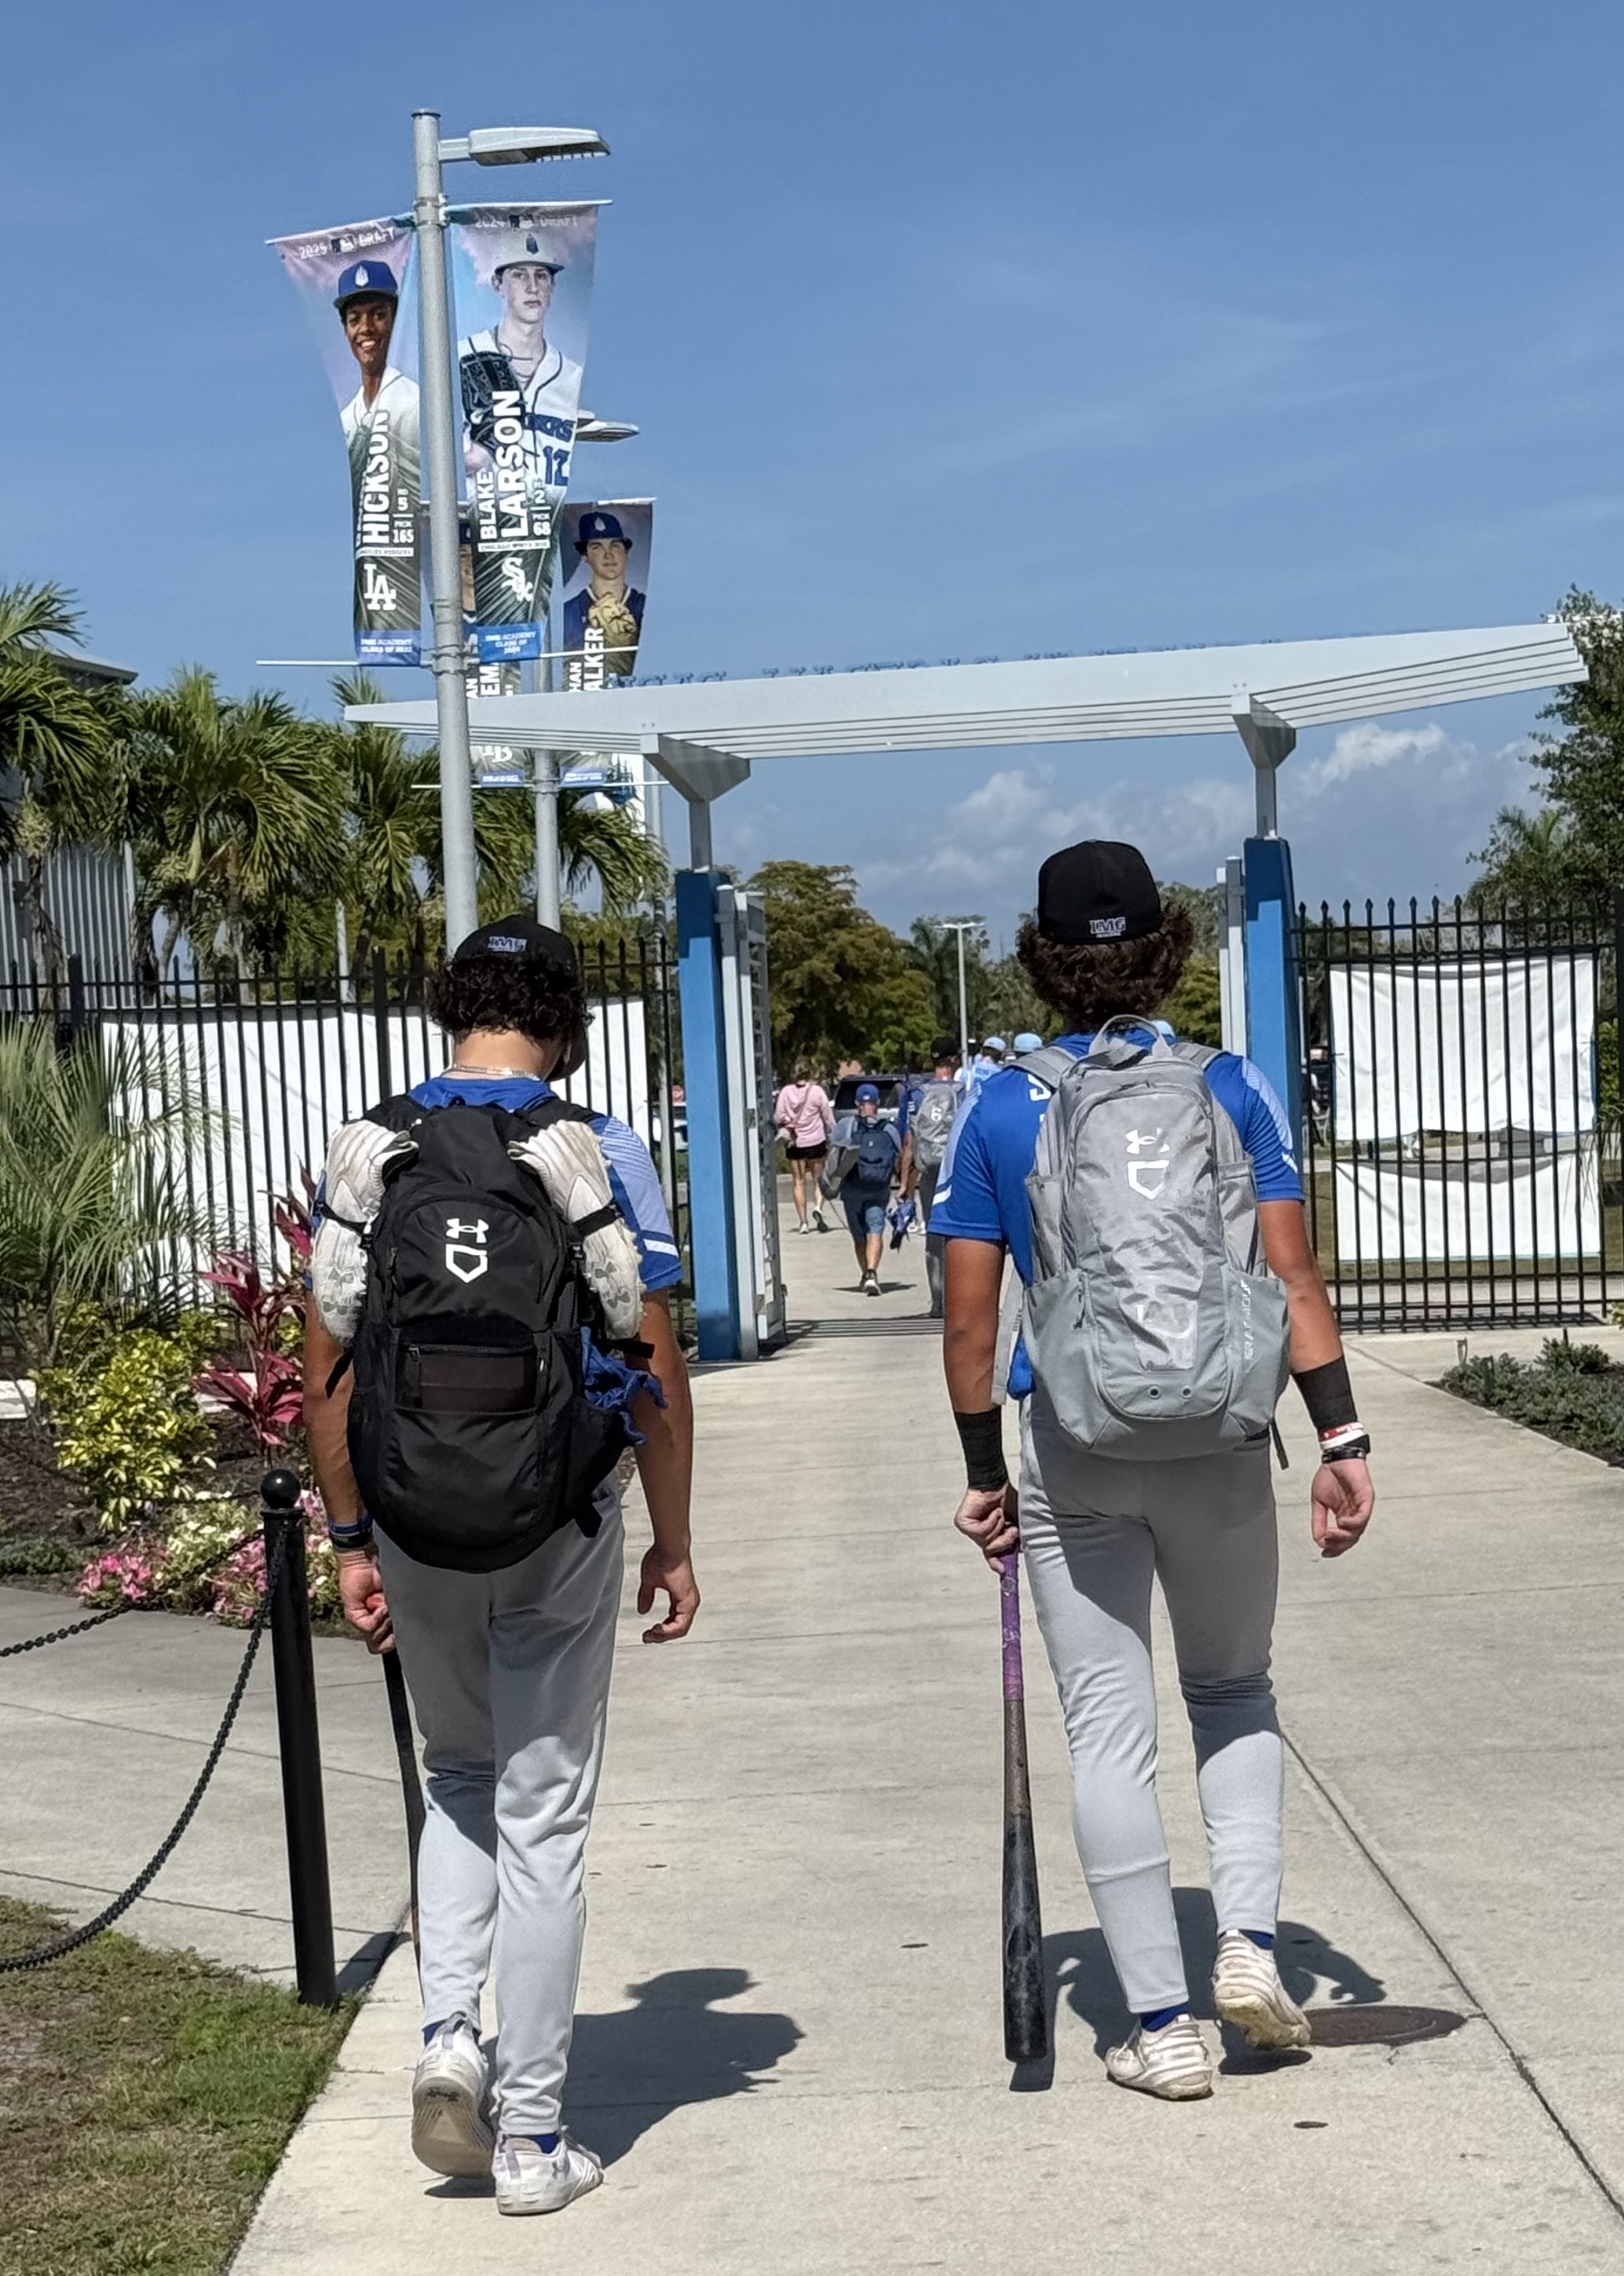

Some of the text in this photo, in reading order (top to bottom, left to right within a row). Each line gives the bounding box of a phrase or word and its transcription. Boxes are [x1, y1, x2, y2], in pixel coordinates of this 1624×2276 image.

[492, 390, 529, 537] LARSON
[362, 412, 390, 543] HICKSON
[397, 496, 408, 510] 5
[534, 489, 545, 503] 2
[476, 470, 498, 540] BLAKE
[393, 529, 414, 543] 165
[533, 521, 551, 536] 68
[364, 564, 397, 610] LA
[931, 1107, 942, 1122] 6
